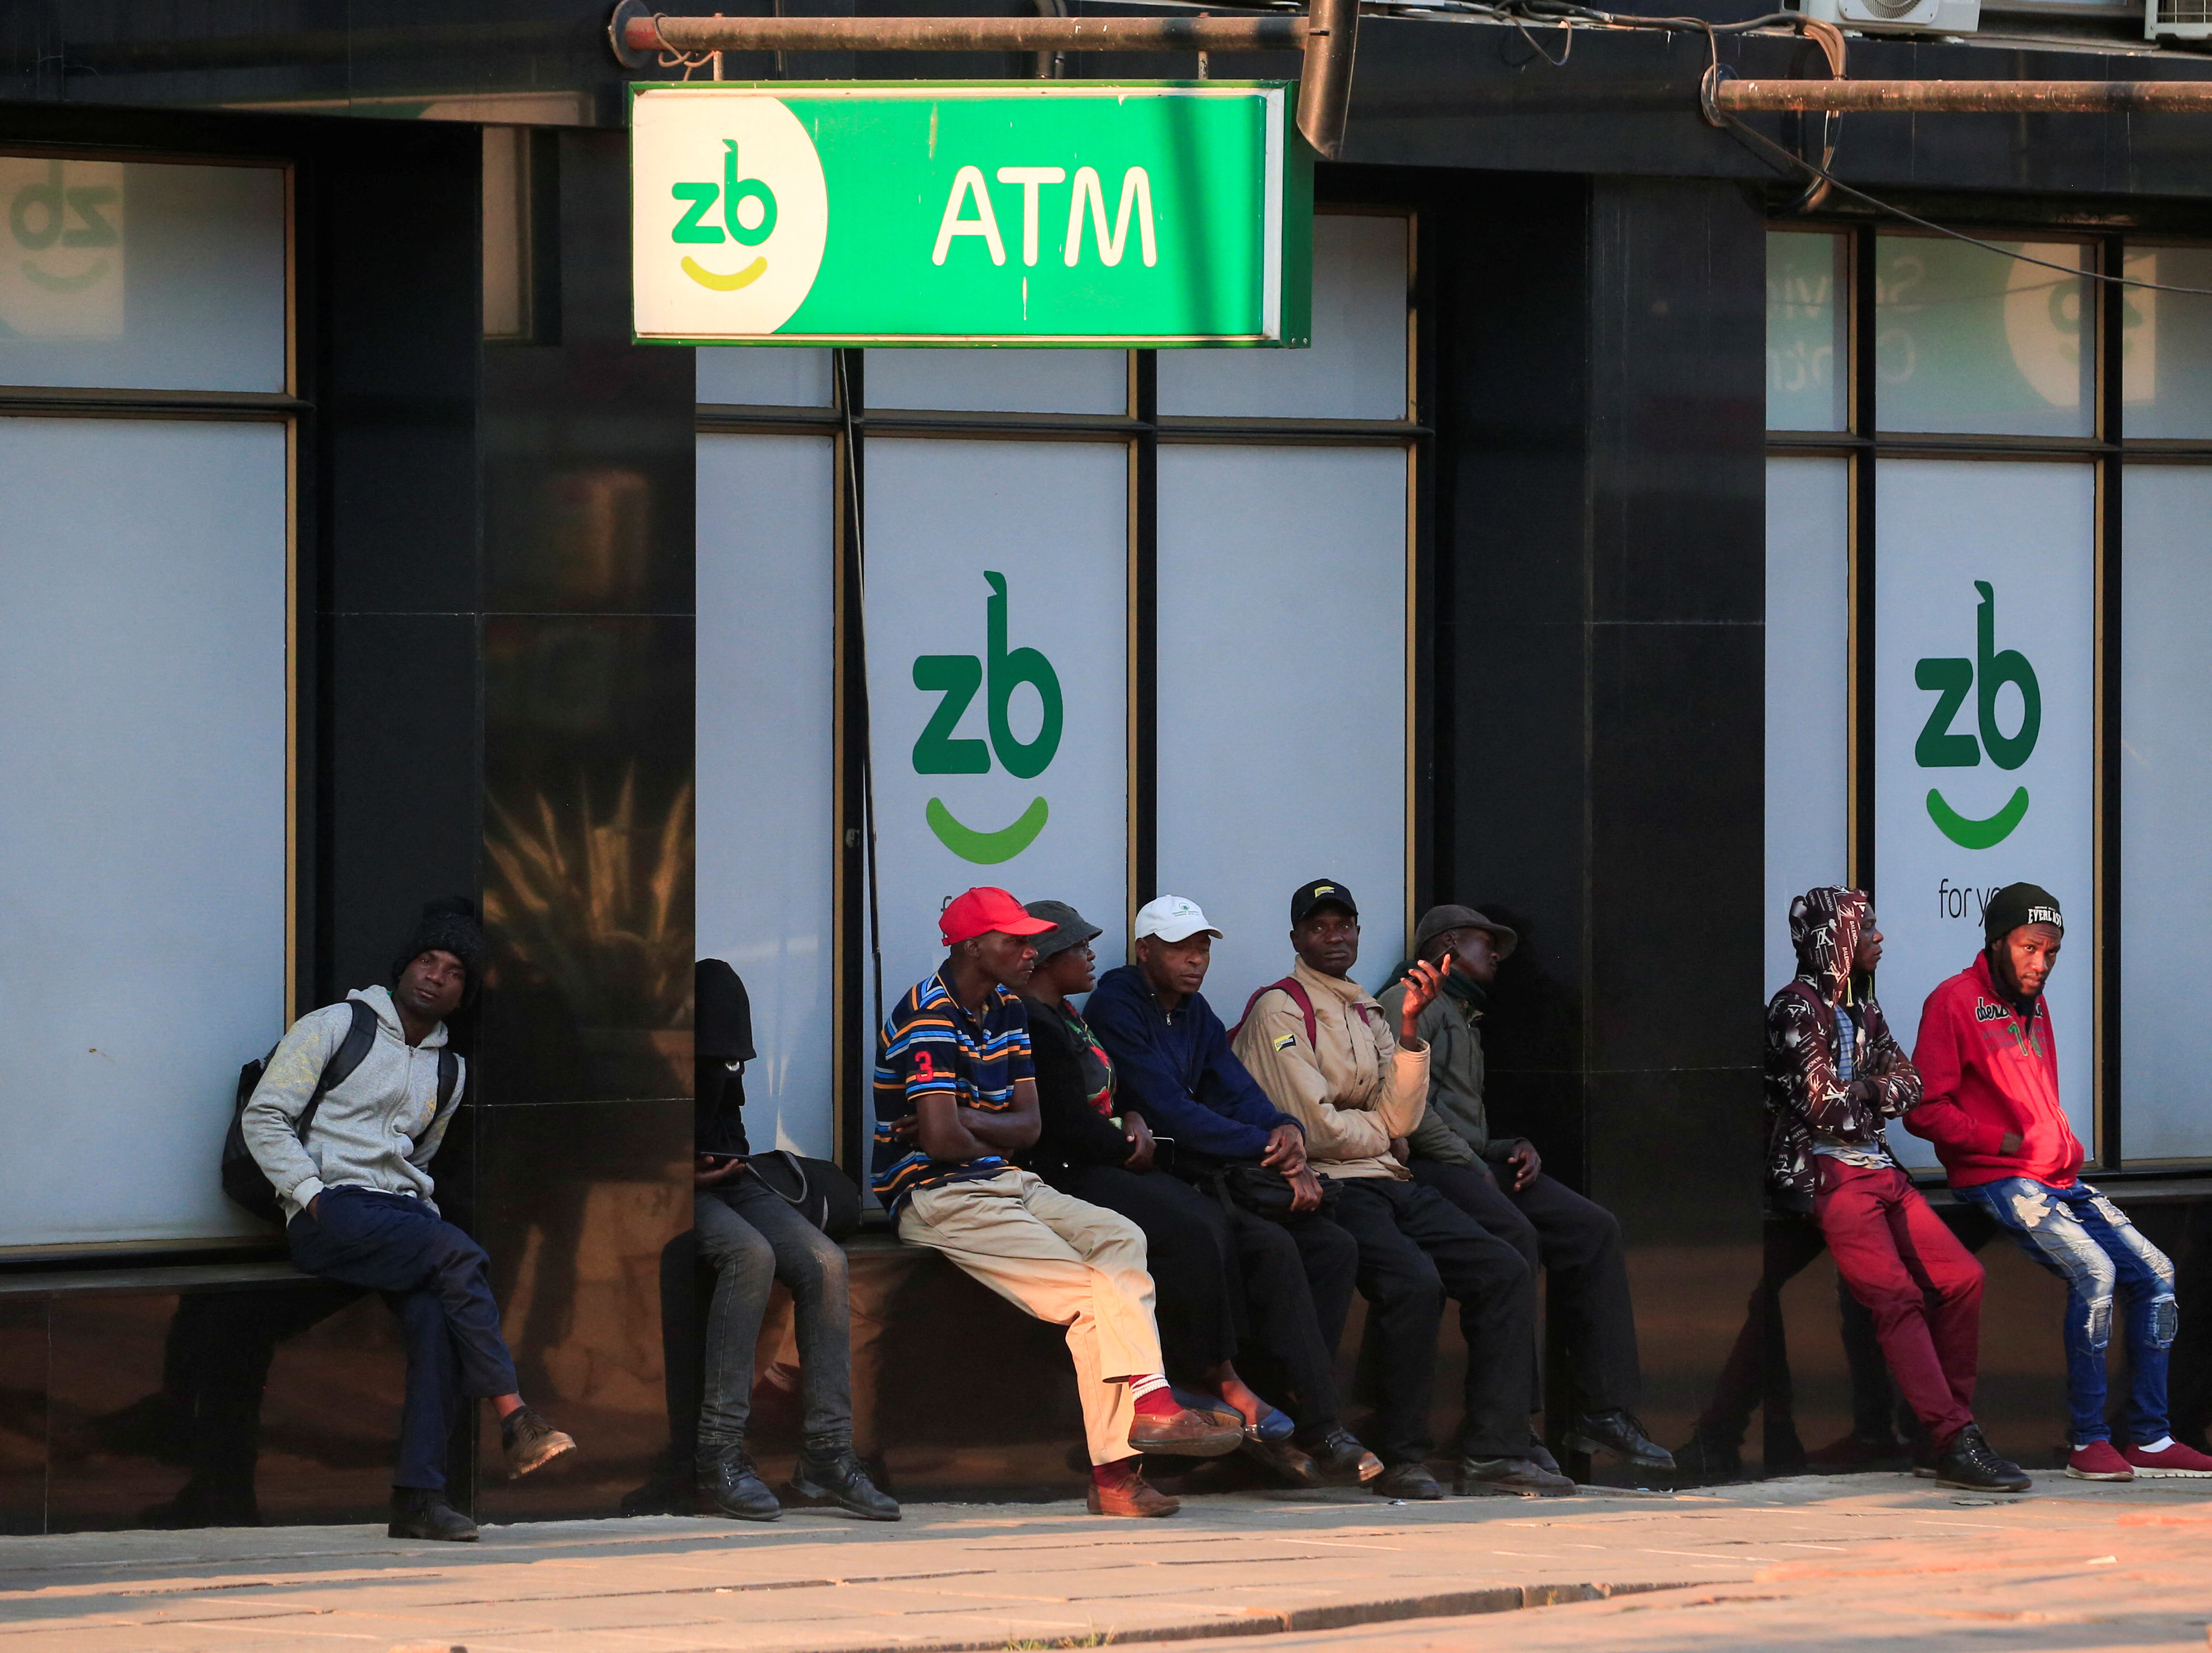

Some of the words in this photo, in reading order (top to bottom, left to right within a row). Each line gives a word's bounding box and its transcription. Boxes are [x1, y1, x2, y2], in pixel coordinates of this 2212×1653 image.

[671, 139, 777, 246] zb
[932, 165, 1157, 268] ATM
[912, 570, 1063, 779] zb
[1915, 580, 2041, 770] zb
[1939, 879, 1972, 918] for
[914, 1051, 934, 1082] 3
